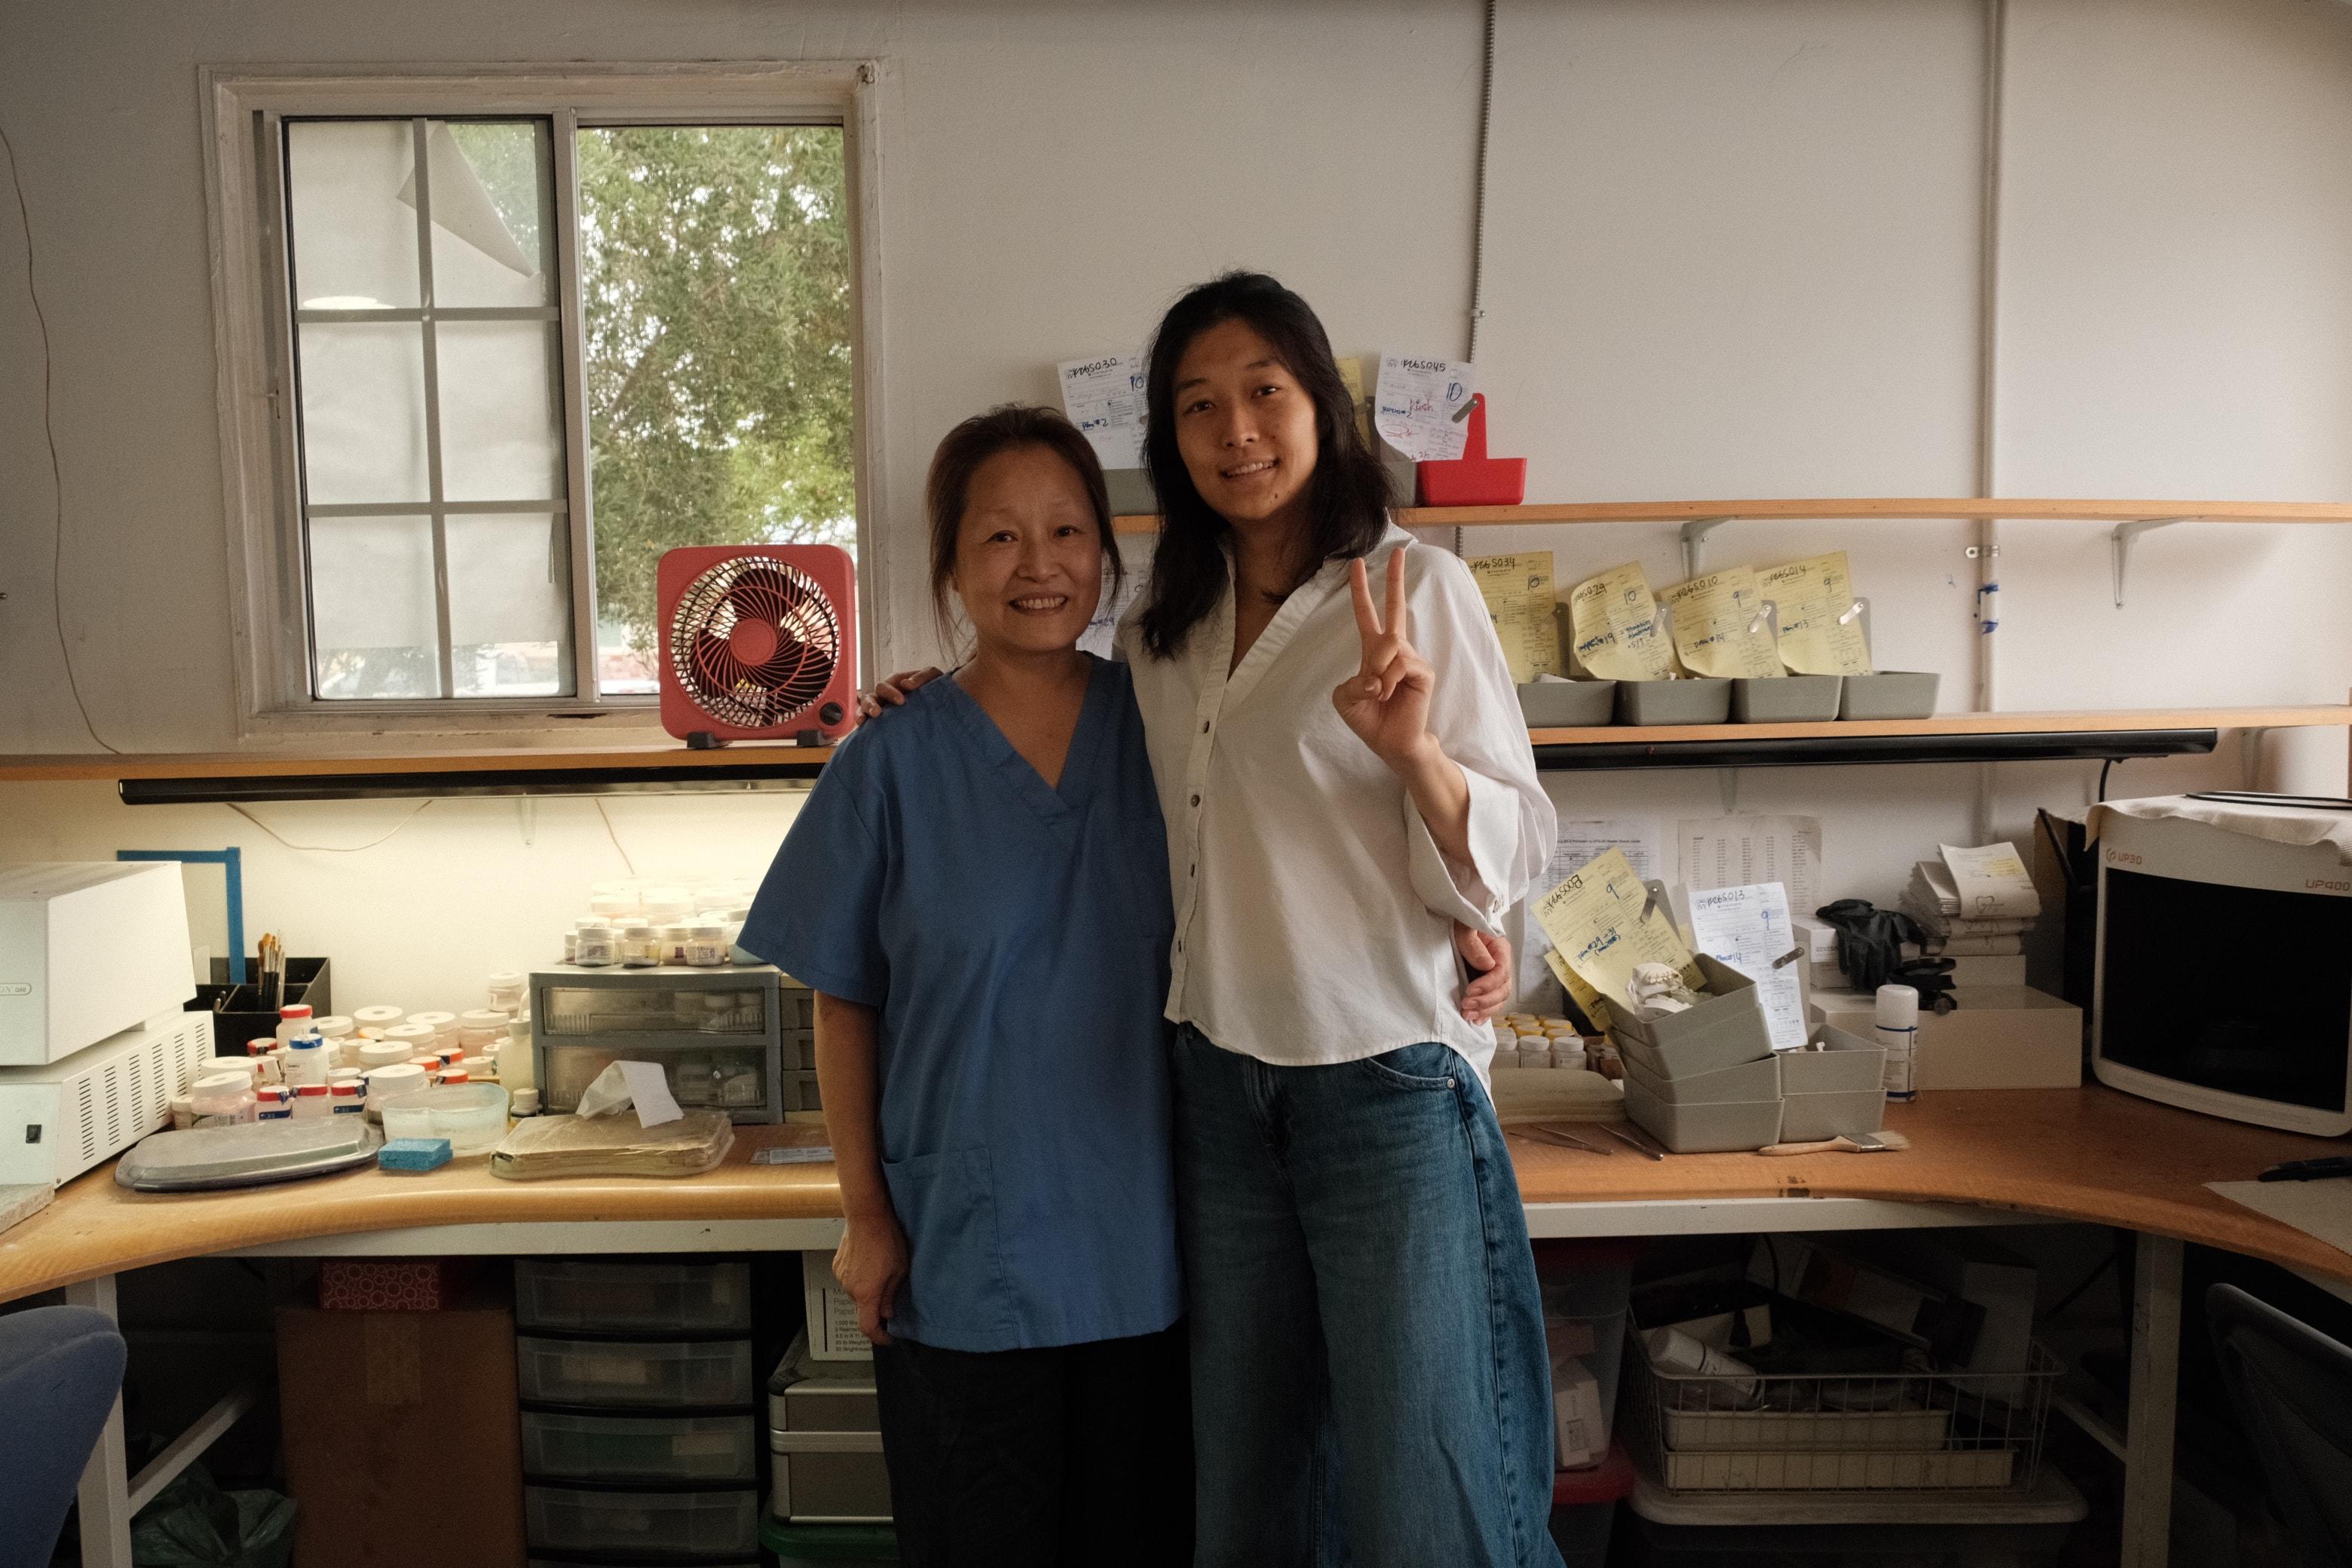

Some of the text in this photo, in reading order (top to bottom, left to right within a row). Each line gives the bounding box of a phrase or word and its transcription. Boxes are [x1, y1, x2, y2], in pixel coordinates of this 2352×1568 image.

[1447, 382, 1462, 402] 10
[1527, 577, 1540, 590] 10
[1624, 590, 1637, 605] 10
[2118, 853, 2142, 865] UP3D
[1606, 884, 1619, 900] 9
[2306, 879, 2351, 891] UP400
[1761, 911, 1770, 931] 9
